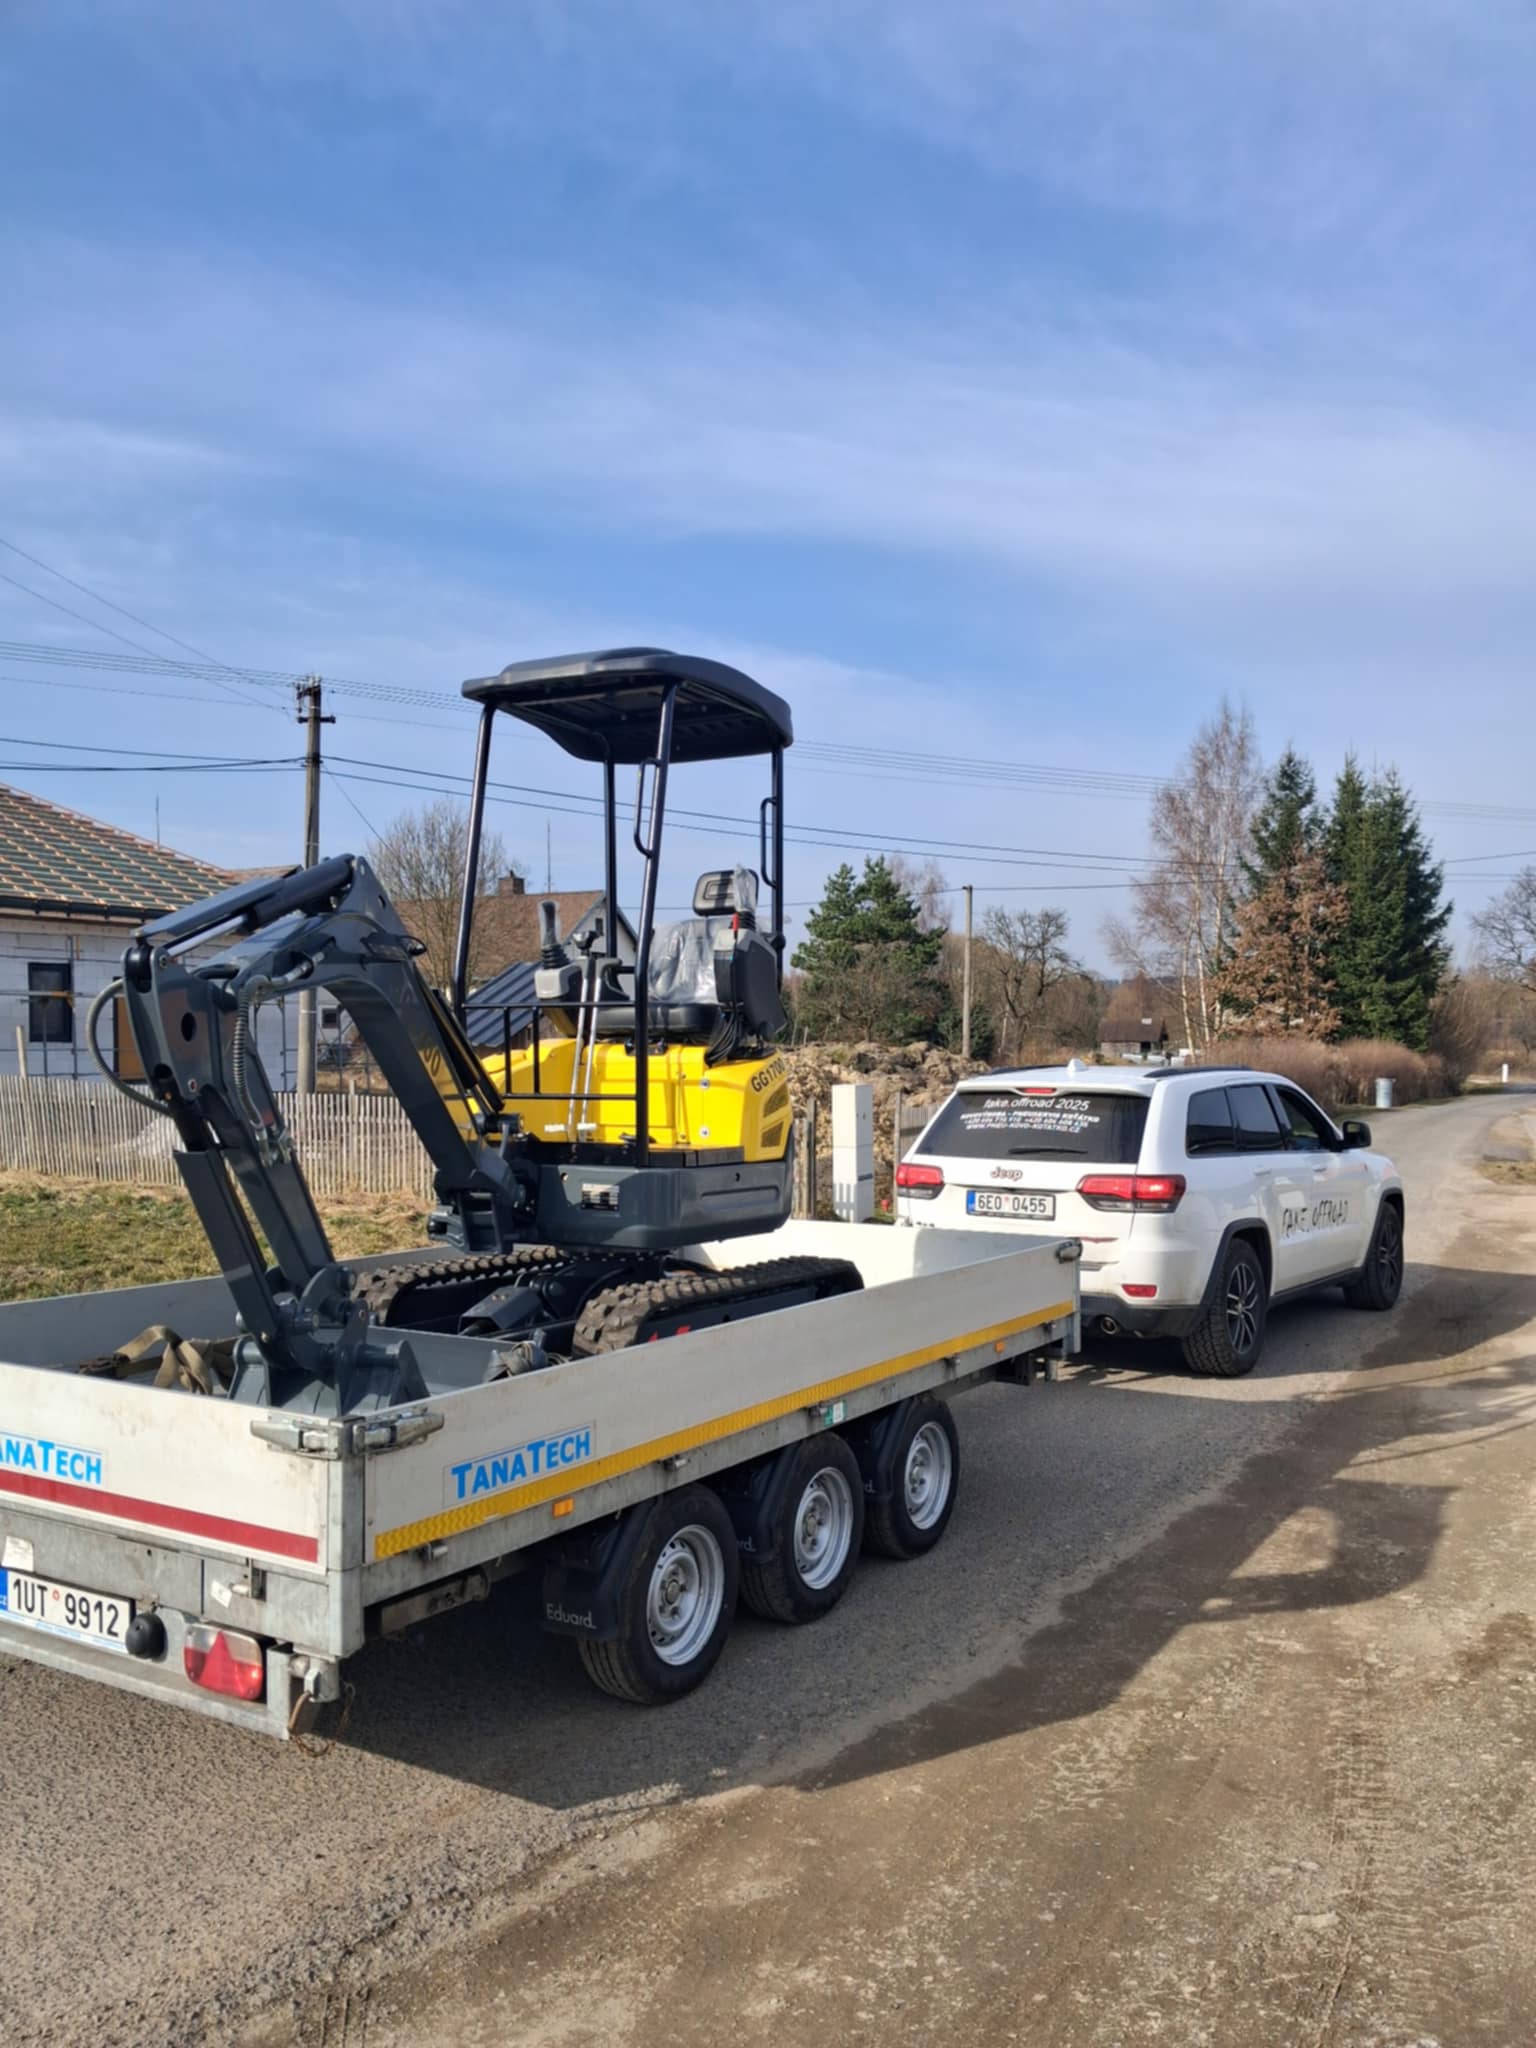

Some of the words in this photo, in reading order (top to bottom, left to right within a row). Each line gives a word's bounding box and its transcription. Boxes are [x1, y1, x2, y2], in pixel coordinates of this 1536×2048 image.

[1055, 1098, 1091, 1111] 2025
[991, 1166, 1023, 1181] Jeep
[1012, 1196, 1047, 1213] 0455
[13, 1578, 48, 1617] 1UT
[65, 1593, 119, 1637] 9912
[546, 1603, 597, 1630] Eduard
